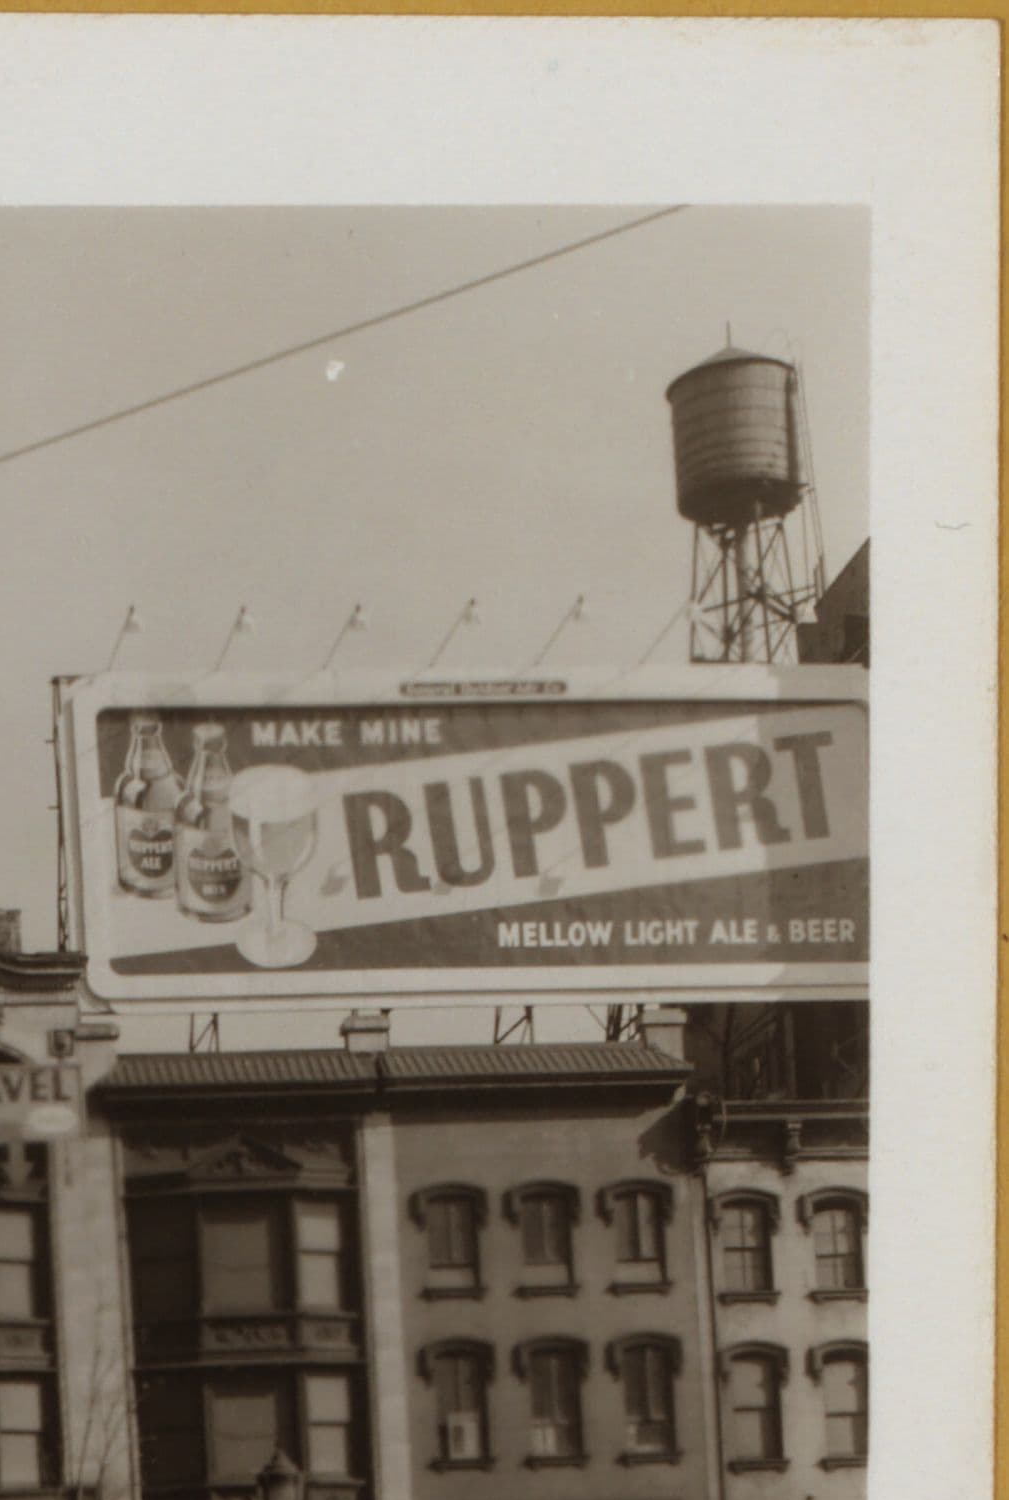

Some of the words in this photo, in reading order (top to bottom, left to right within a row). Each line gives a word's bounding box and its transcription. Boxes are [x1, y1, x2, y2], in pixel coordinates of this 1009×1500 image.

[252, 720, 342, 746] MAKE
[360, 717, 441, 744] MINE
[342, 731, 833, 899] RUPPERT
[498, 922, 613, 948] MELLOW
[624, 919, 698, 946] LIGHT
[709, 918, 759, 944] ALE
[767, 924, 781, 943] &
[789, 918, 856, 943] BEER
